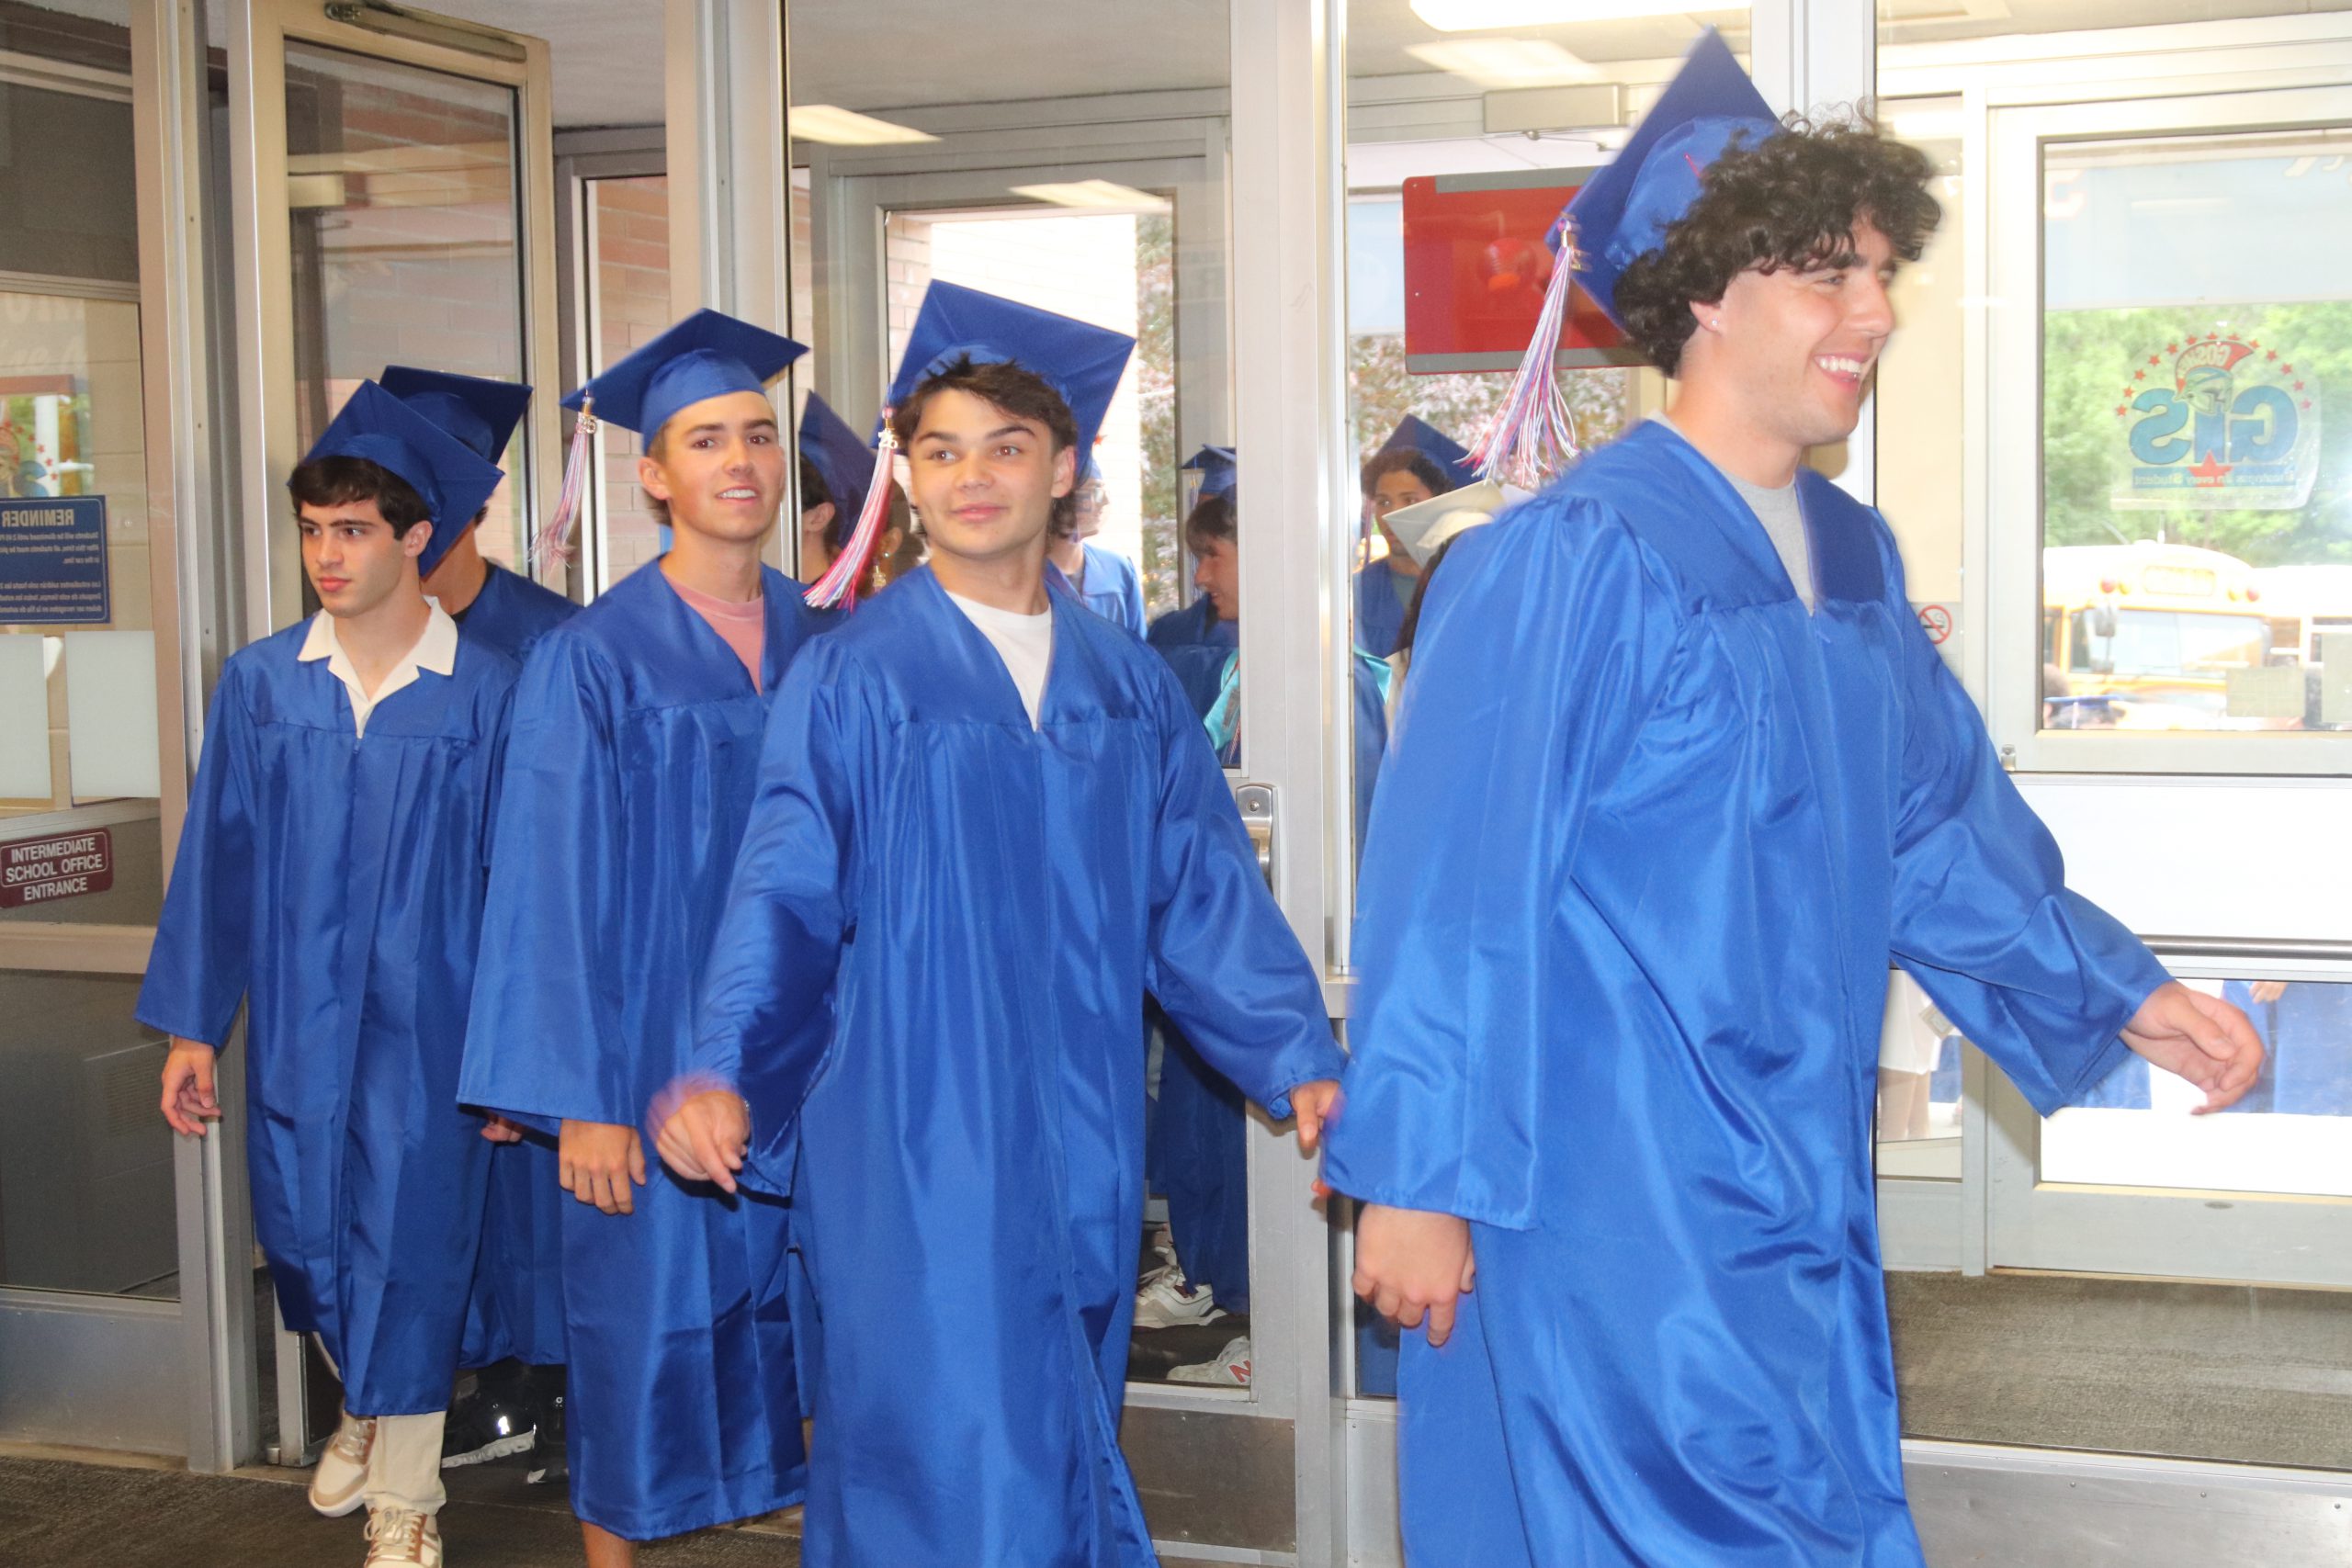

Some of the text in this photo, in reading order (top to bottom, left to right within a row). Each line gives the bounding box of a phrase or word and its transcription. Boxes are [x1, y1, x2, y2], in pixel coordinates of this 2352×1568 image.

[11, 837, 96, 863] INTERMEDIATE
[6, 853, 103, 883] SCHOOL OFFICE
[24, 877, 88, 901] ENTRANCE
